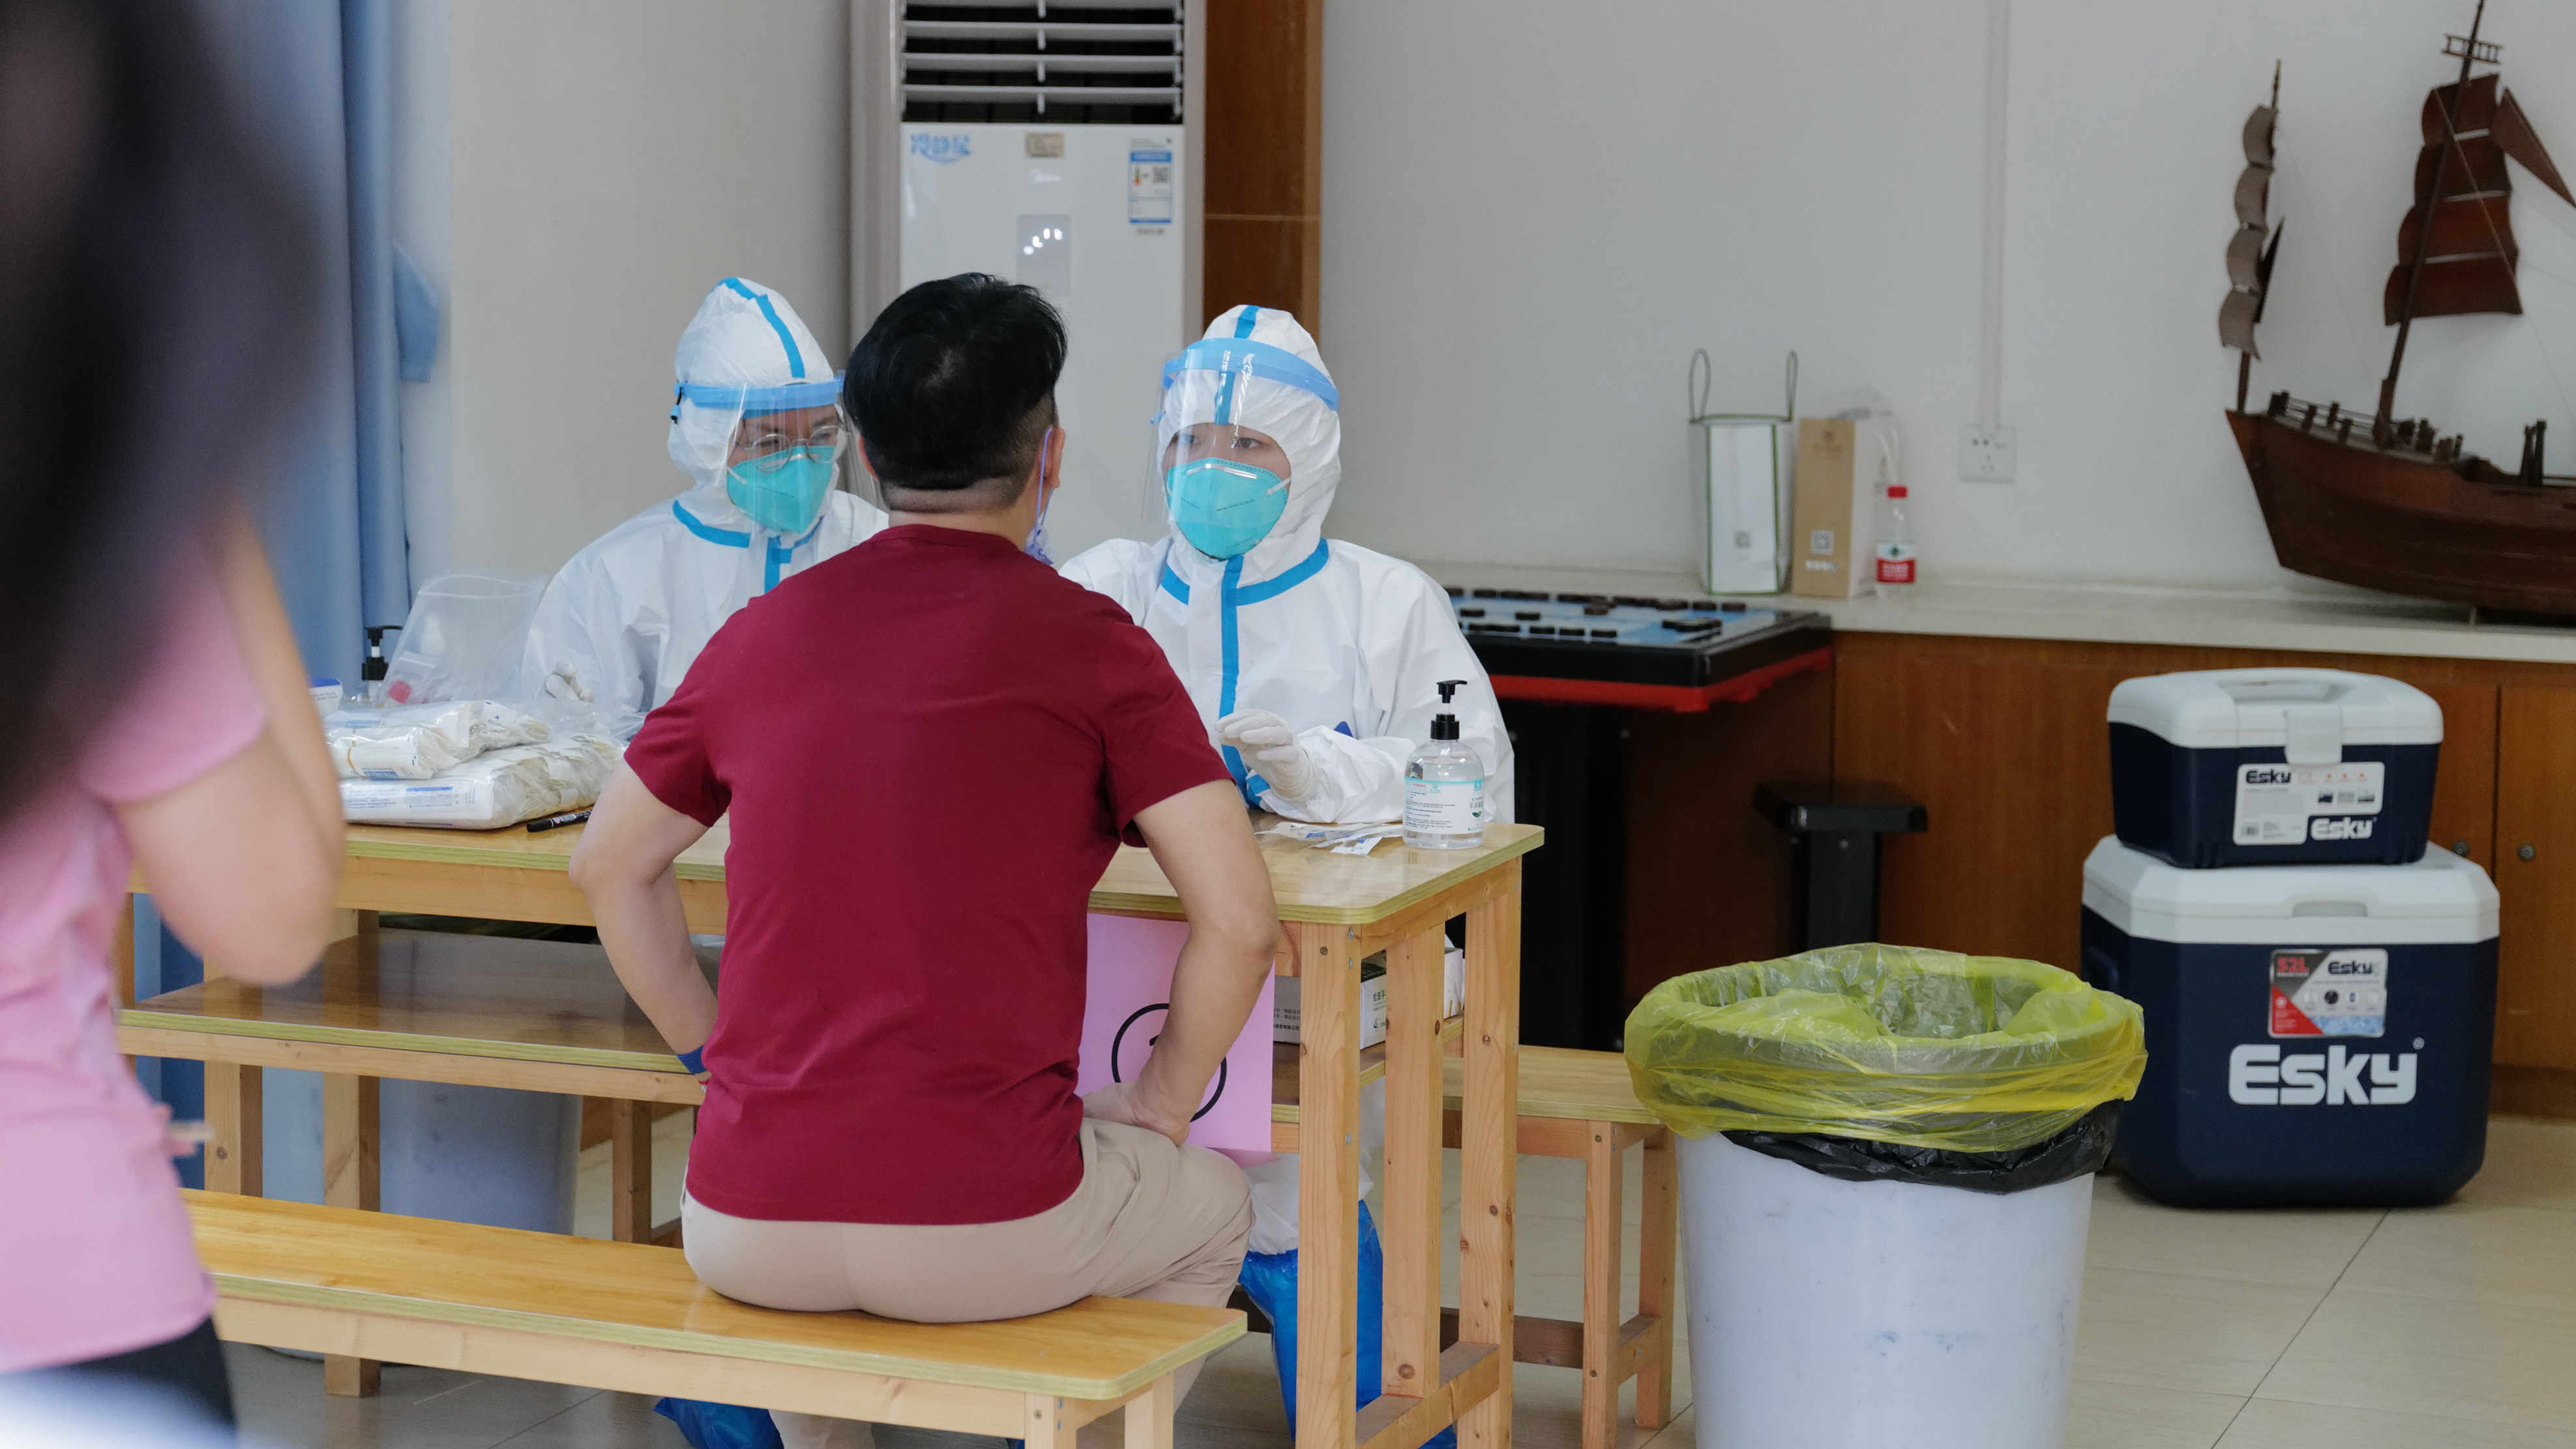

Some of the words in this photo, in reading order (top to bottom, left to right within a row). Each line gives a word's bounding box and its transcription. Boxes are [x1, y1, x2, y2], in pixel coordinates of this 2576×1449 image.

[2246, 769, 2291, 784] Esky
[2310, 817, 2373, 840] Esky
[2277, 957, 2309, 973] 52L
[2328, 961, 2373, 974] Esky
[2228, 1044, 2418, 1105] Esky
